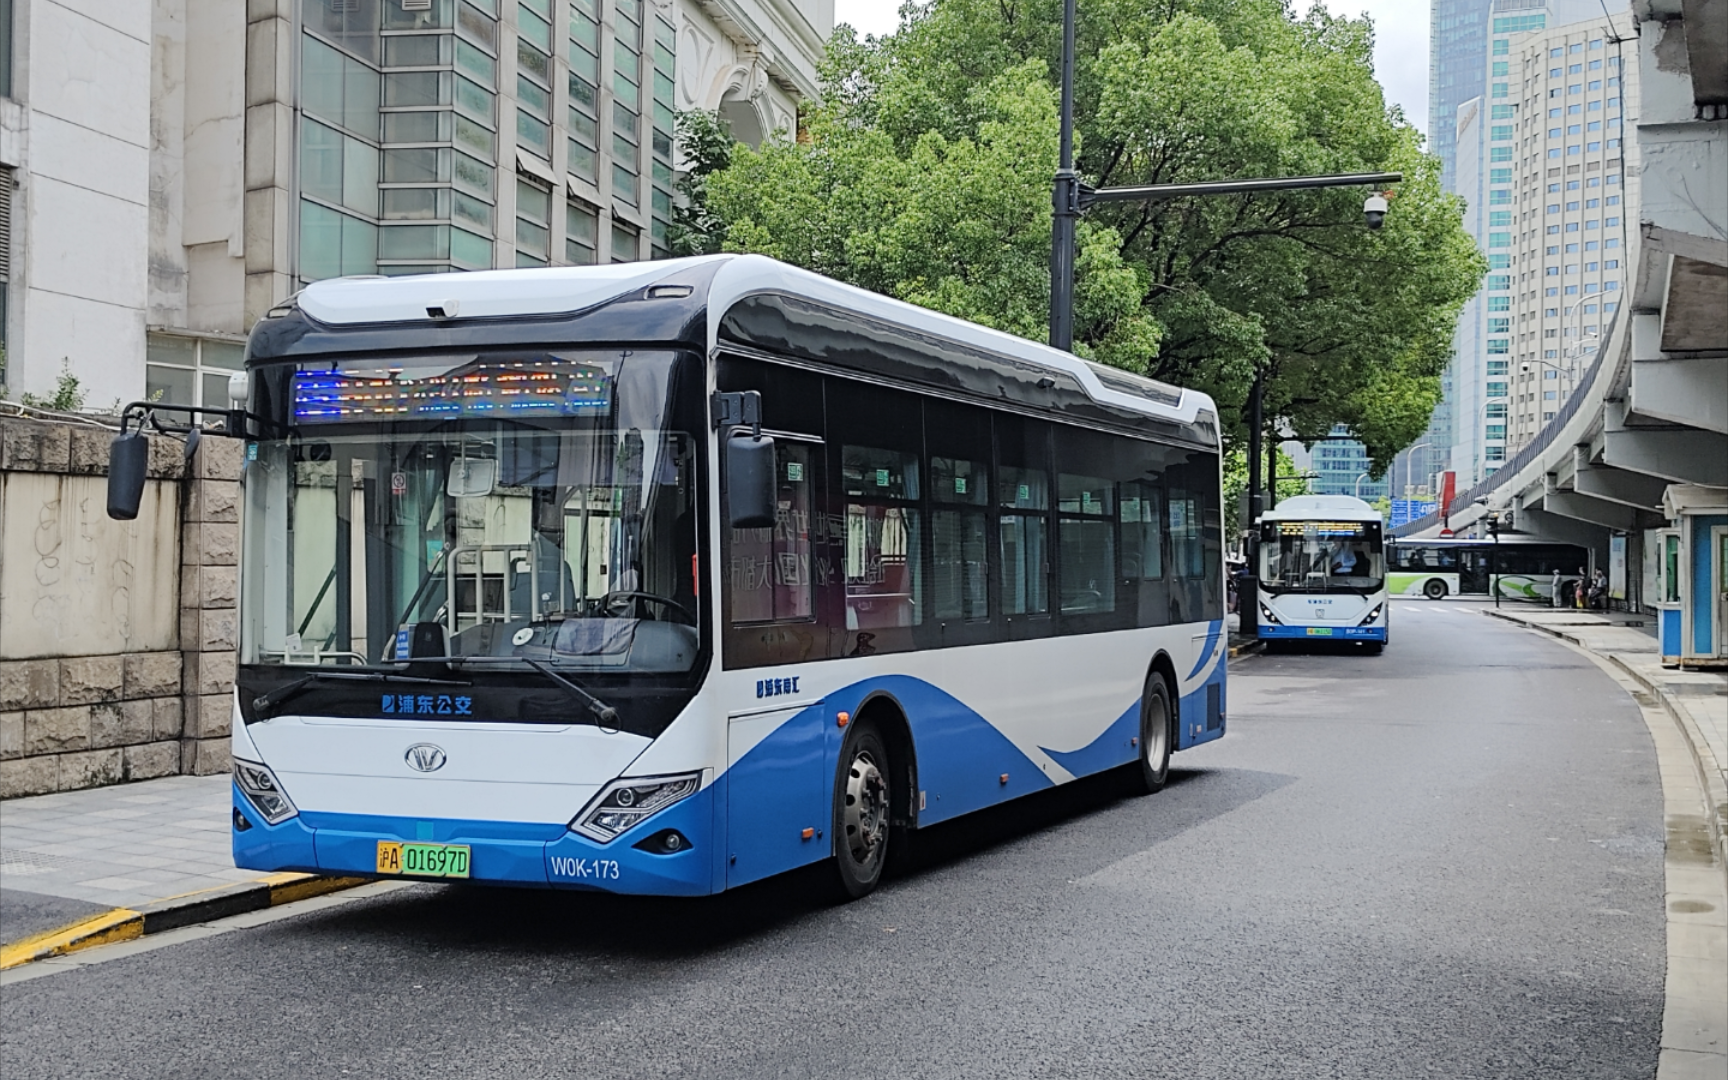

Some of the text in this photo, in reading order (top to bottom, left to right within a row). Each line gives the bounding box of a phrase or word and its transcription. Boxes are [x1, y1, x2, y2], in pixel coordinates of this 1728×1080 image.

[398, 694, 472, 715] 浦东公交
[379, 847, 468, 873] 沪A 01697D
